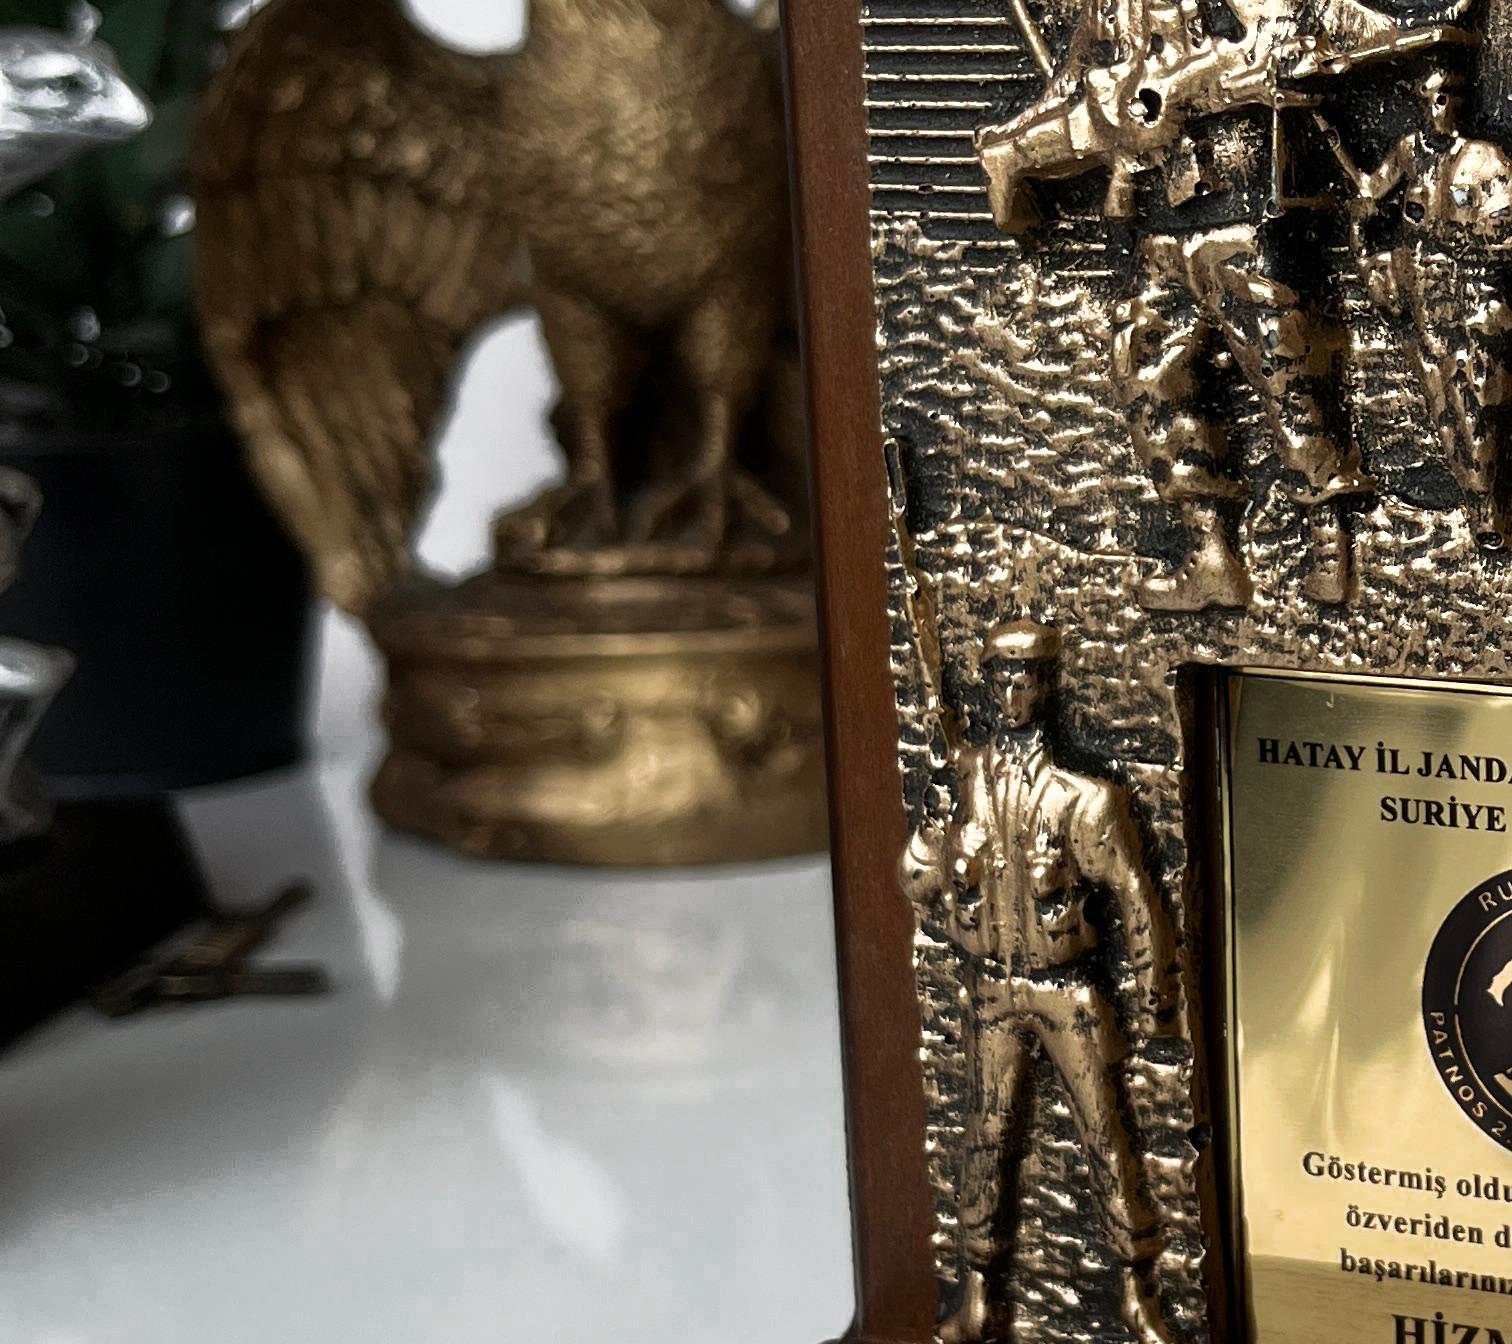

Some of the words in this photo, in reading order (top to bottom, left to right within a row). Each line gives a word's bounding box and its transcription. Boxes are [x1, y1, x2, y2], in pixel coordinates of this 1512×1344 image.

[1258, 738, 1366, 770] HATAY
[1376, 741, 1409, 775] İL
[1381, 796, 1506, 832] SURİYE
[1430, 1012, 1488, 1118] PATNOS
[1302, 1152, 1446, 1197] Göstermiş
[1346, 1204, 1483, 1244] özveriden
